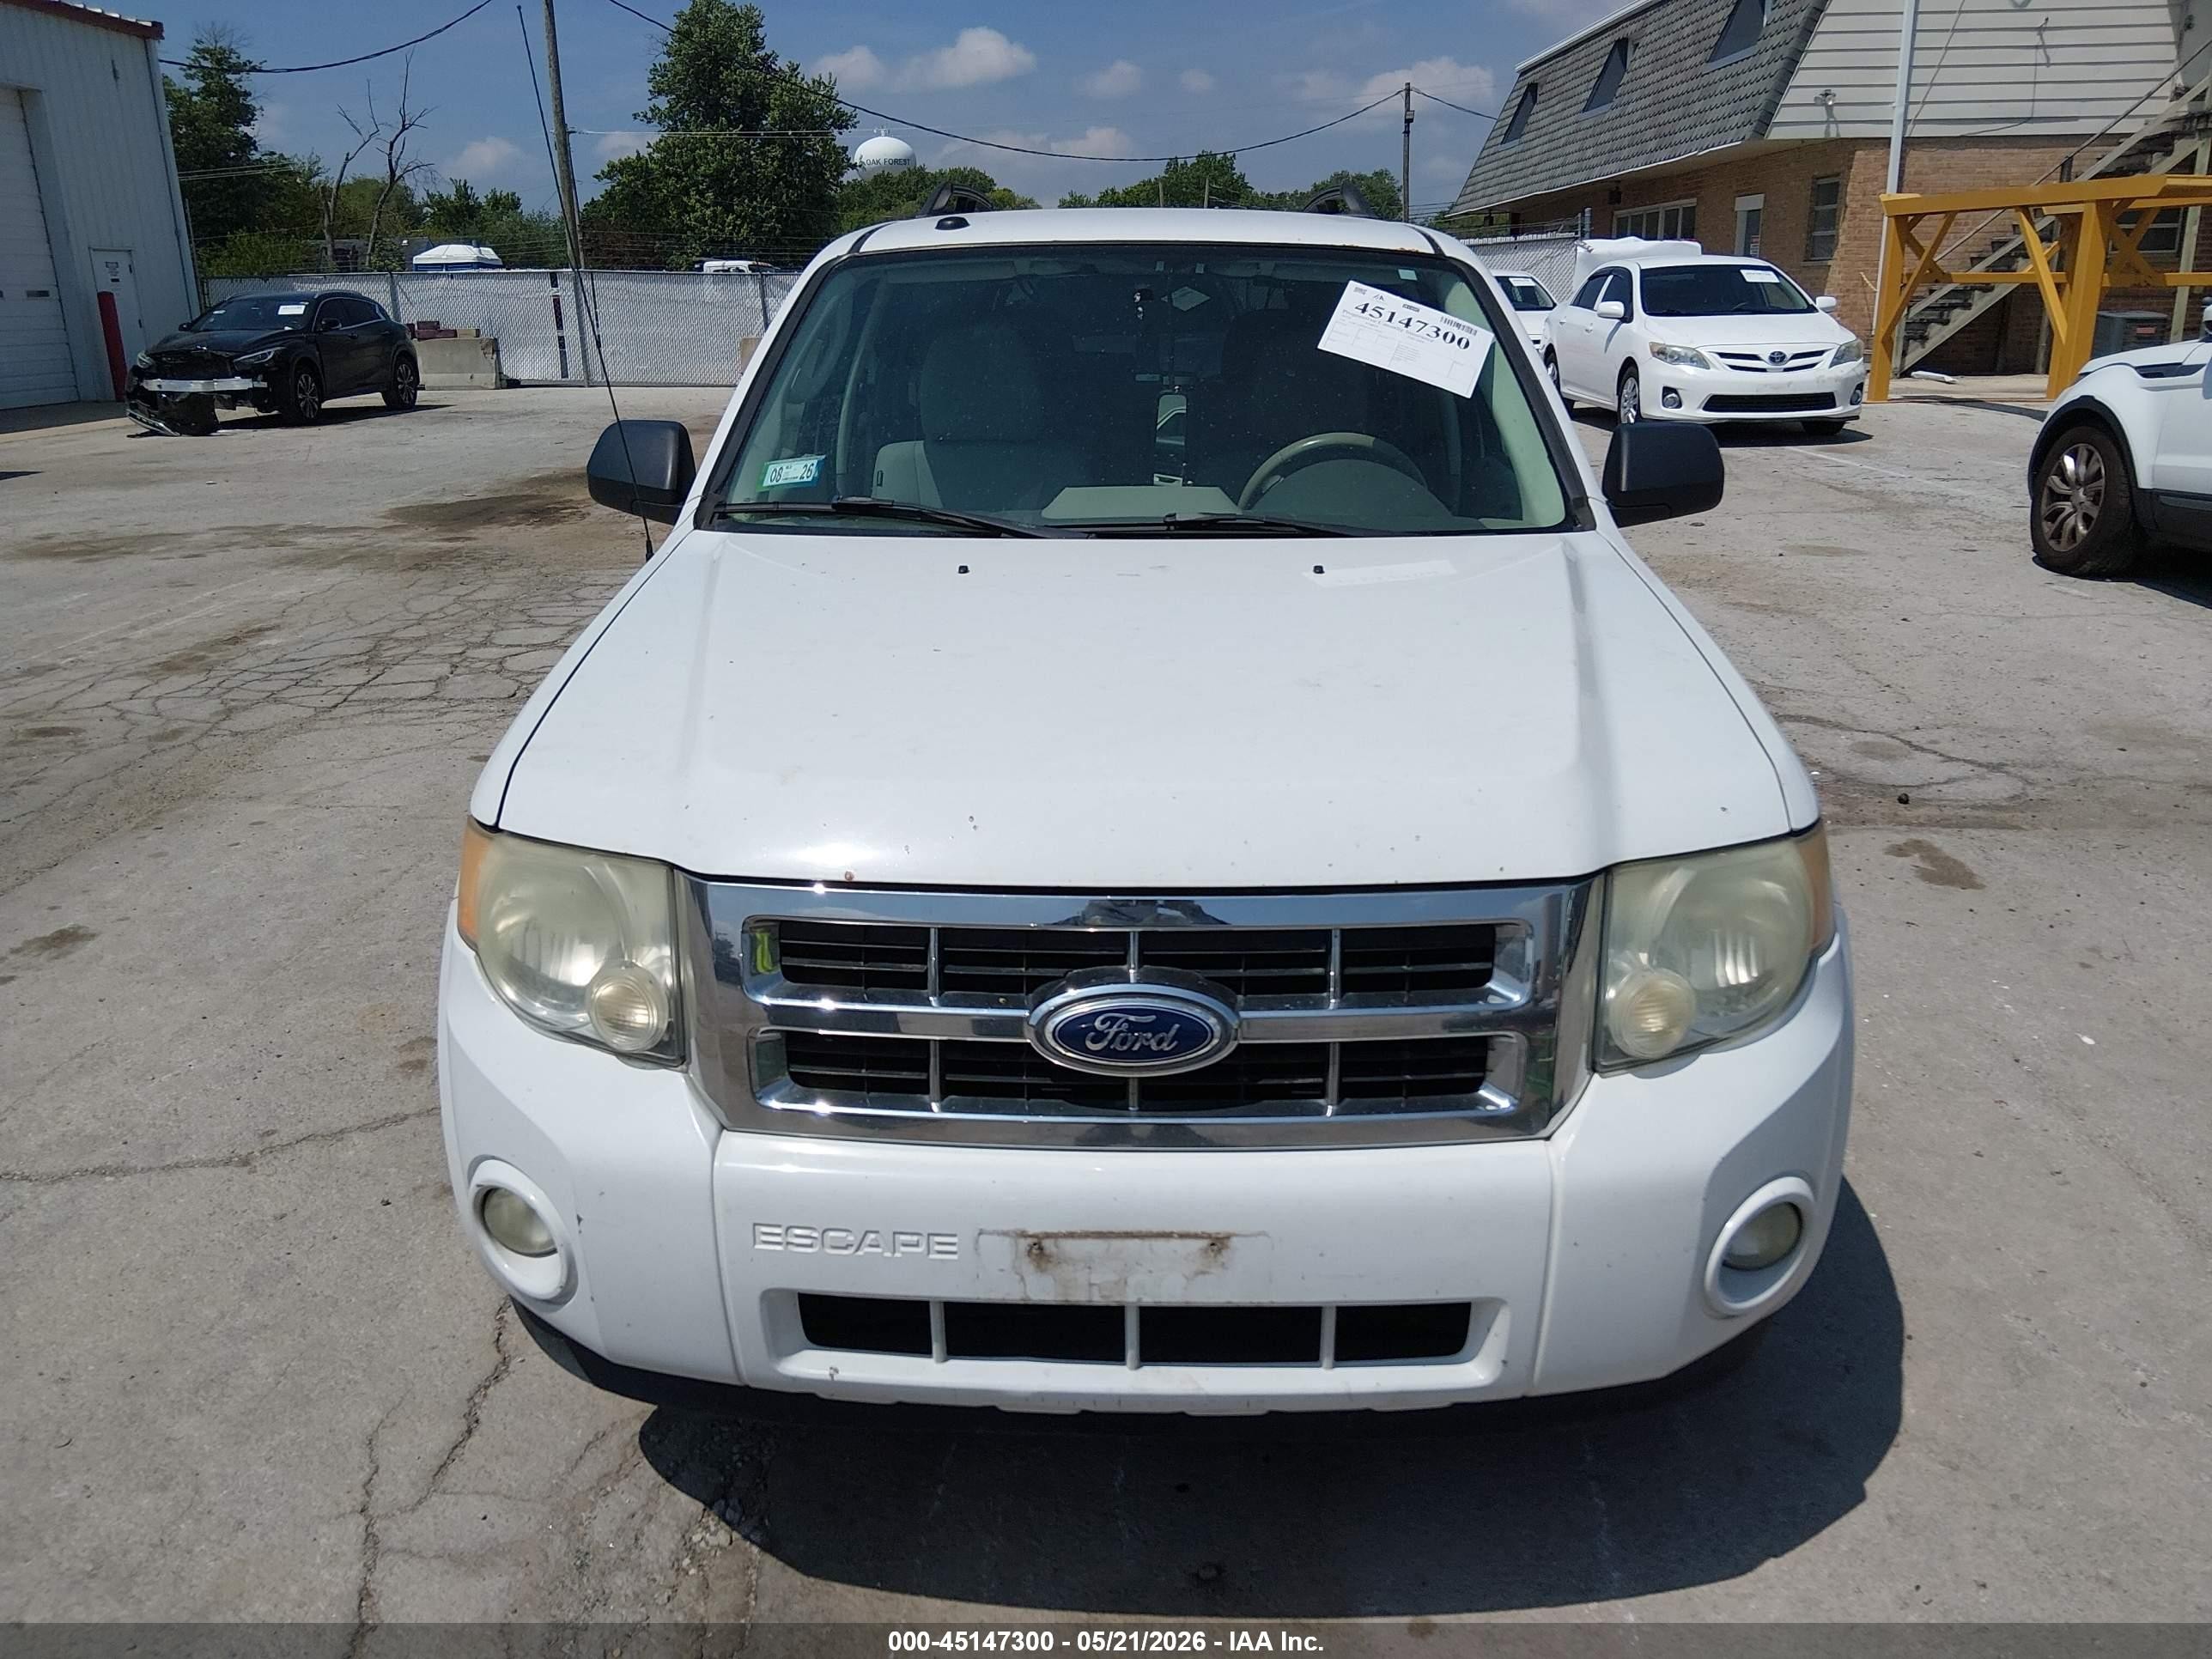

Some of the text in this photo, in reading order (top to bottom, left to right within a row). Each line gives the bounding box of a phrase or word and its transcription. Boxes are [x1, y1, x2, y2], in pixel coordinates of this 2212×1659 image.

[1354, 301, 1471, 350] 45147300
[770, 466, 783, 483] 08
[800, 464, 814, 479] 26
[1085, 1012, 1180, 1051] Ford
[753, 1223, 958, 1260] ESCAPE
